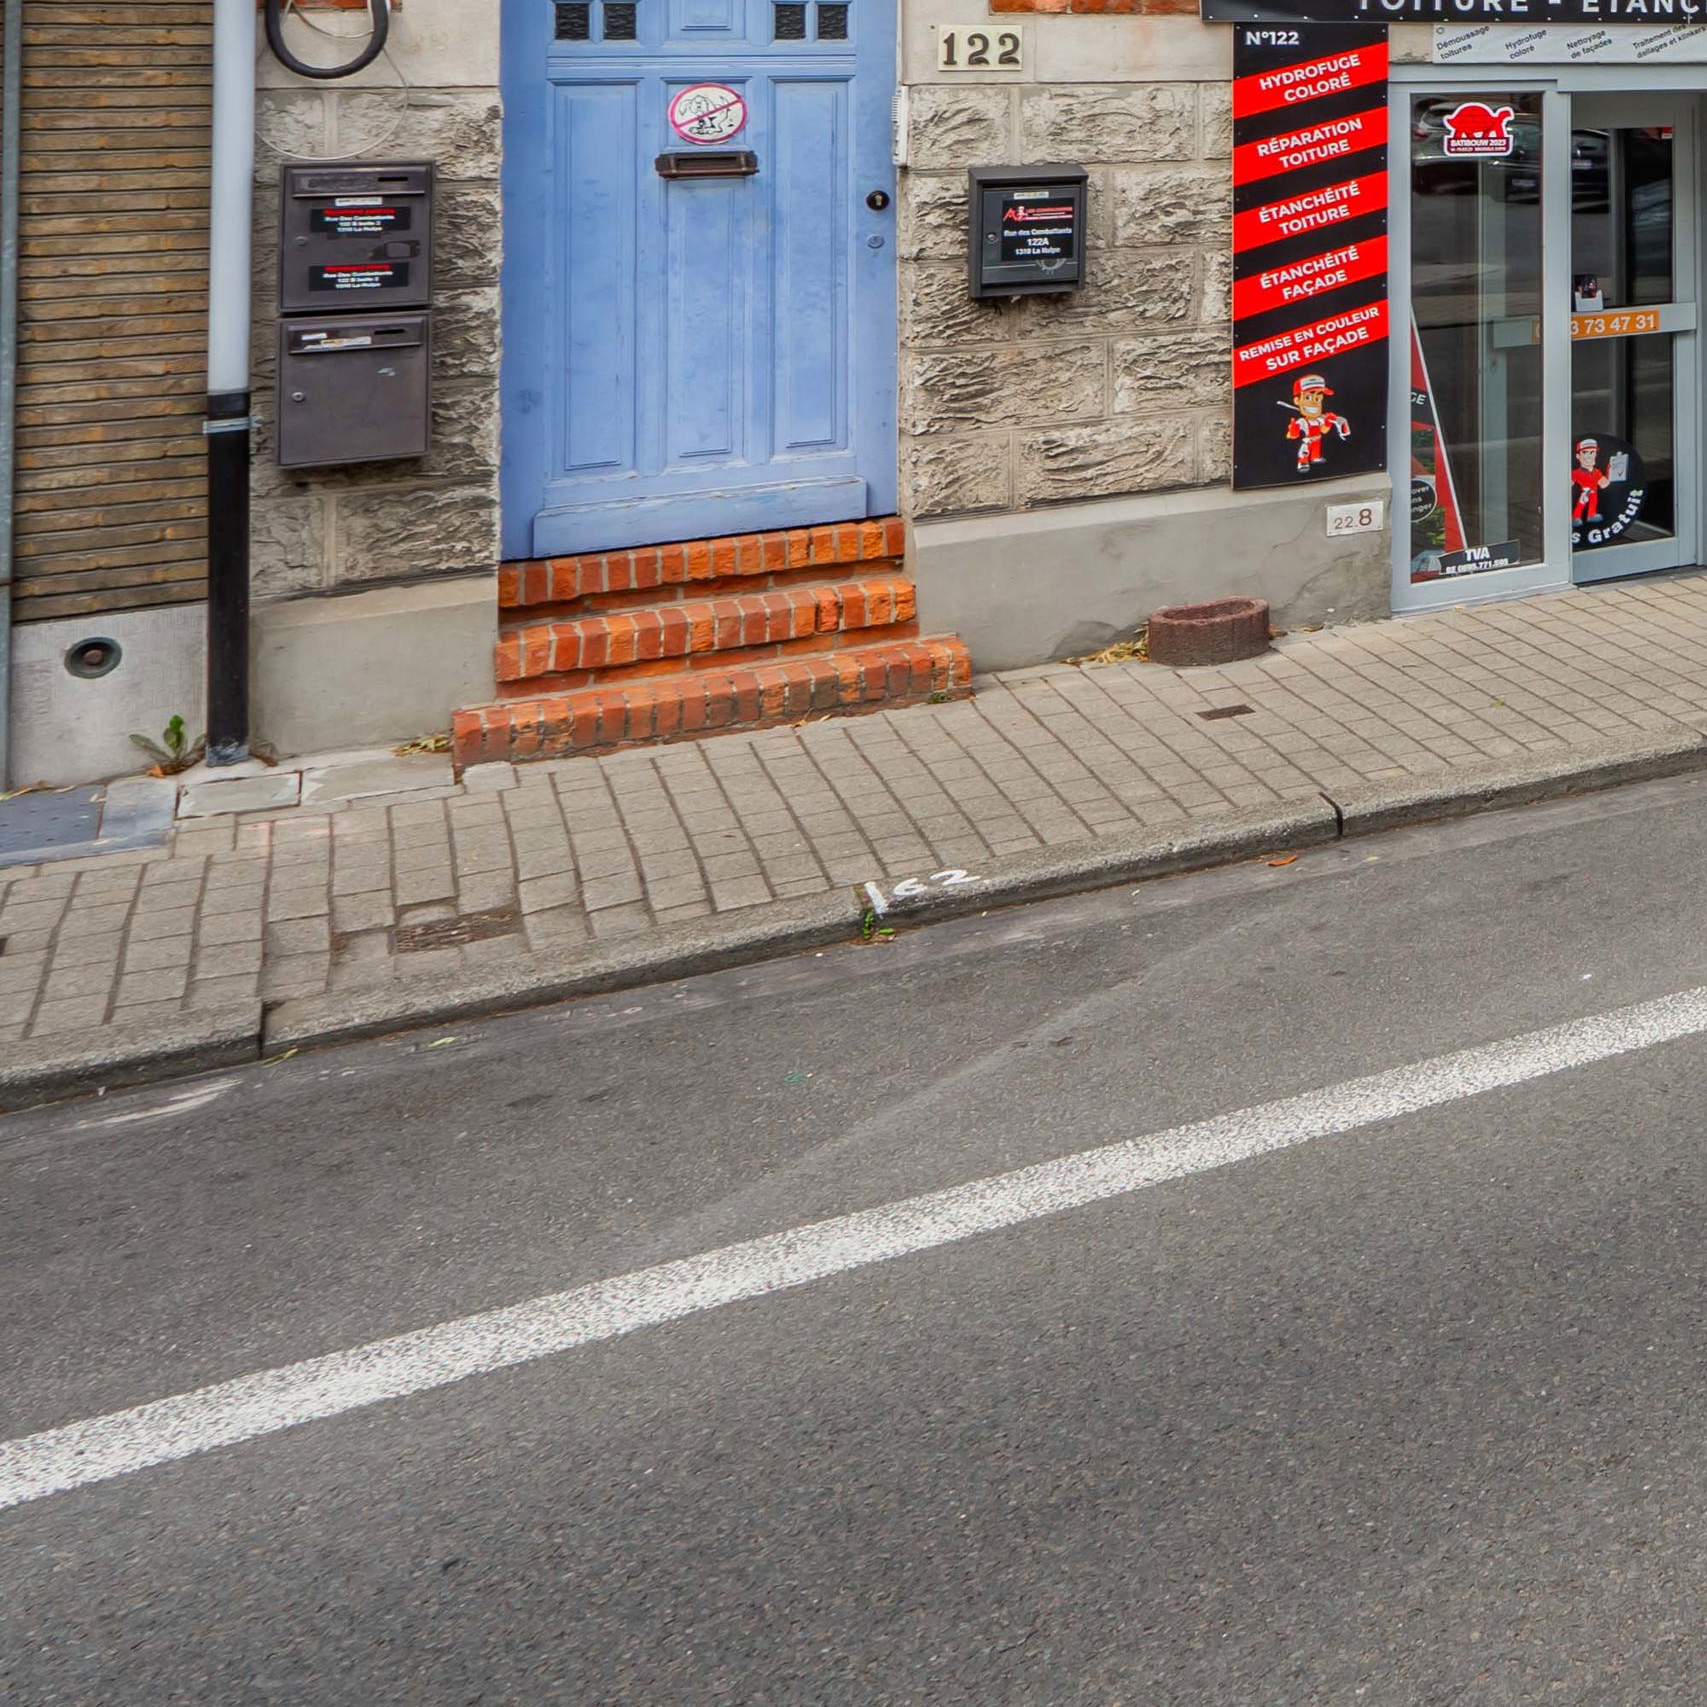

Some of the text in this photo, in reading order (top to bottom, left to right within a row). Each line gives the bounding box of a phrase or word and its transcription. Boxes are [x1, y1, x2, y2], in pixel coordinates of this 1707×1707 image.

[943, 32, 1020, 65] 122
[1245, 31, 1300, 45] N°122
[1504, 28, 1548, 50] Hydrofuge
[1259, 54, 1361, 90] HYDROFUGE
[1284, 71, 1351, 102] COLORÉ
[1257, 118, 1363, 157] RÉPARATION
[1279, 139, 1351, 168] TOITURE
[1258, 181, 1361, 223] ÉTANCHÉITÉ
[1279, 205, 1350, 235] TOITURE
[1259, 246, 1360, 289] ÉTANCHÉITÉ
[1281, 270, 1348, 300] FAÇADE
[1239, 307, 1380, 362] REMISE EN COULEUR
[1585, 318, 1606, 334] 73
[1610, 315, 1631, 332] 47
[1636, 313, 1656, 330] 31
[1265, 327, 1370, 371] SUR FAÇADE
[1334, 508, 1372, 530] 22.8
[1588, 489, 1644, 544] Gratuit
[1465, 547, 1491, 561] TVA
